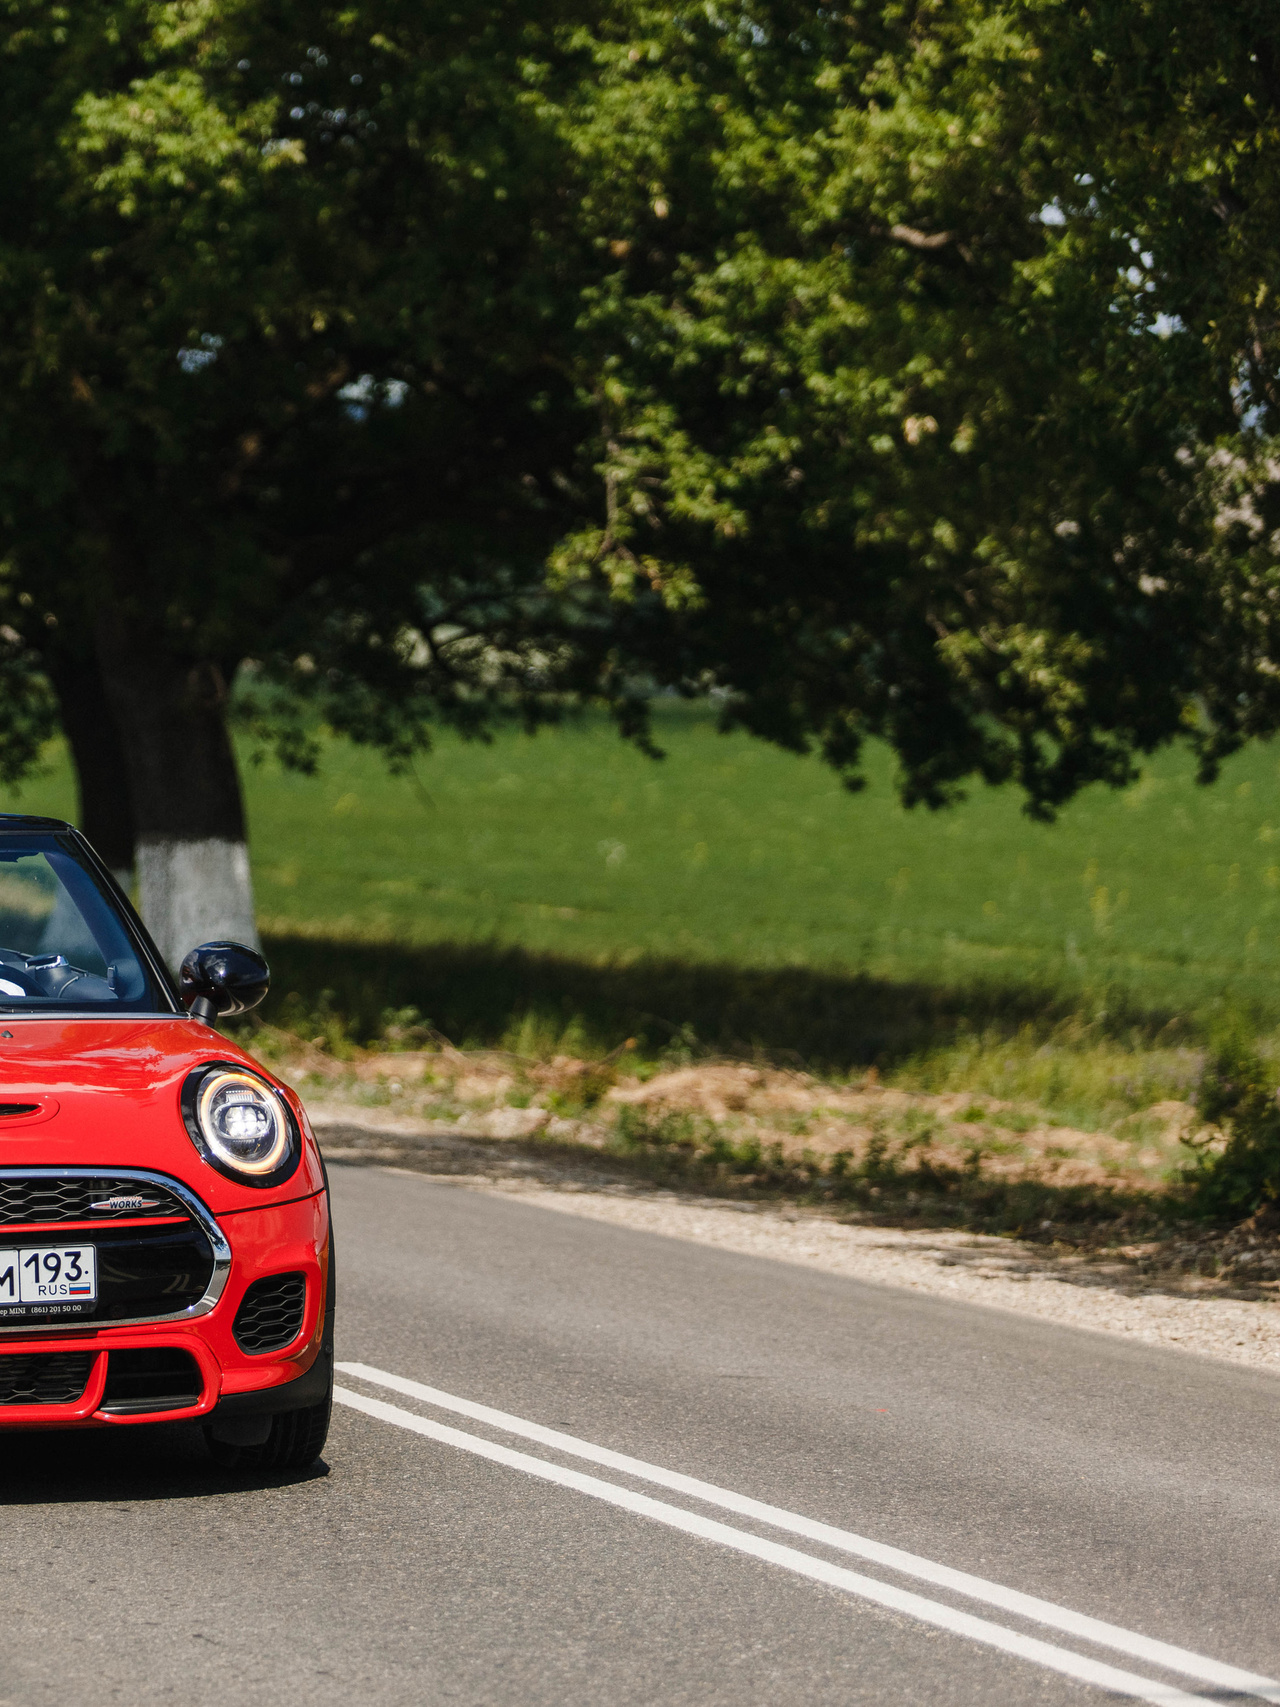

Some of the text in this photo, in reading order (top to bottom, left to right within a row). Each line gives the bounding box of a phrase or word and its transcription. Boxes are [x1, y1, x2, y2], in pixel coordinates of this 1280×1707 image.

[109, 1200, 142, 1209] WORKS
[23, 1251, 82, 1284] 193
[38, 1284, 68, 1296] RUS
[9, 1307, 26, 1315] MINI
[31, 1306, 49, 1314] (861)
